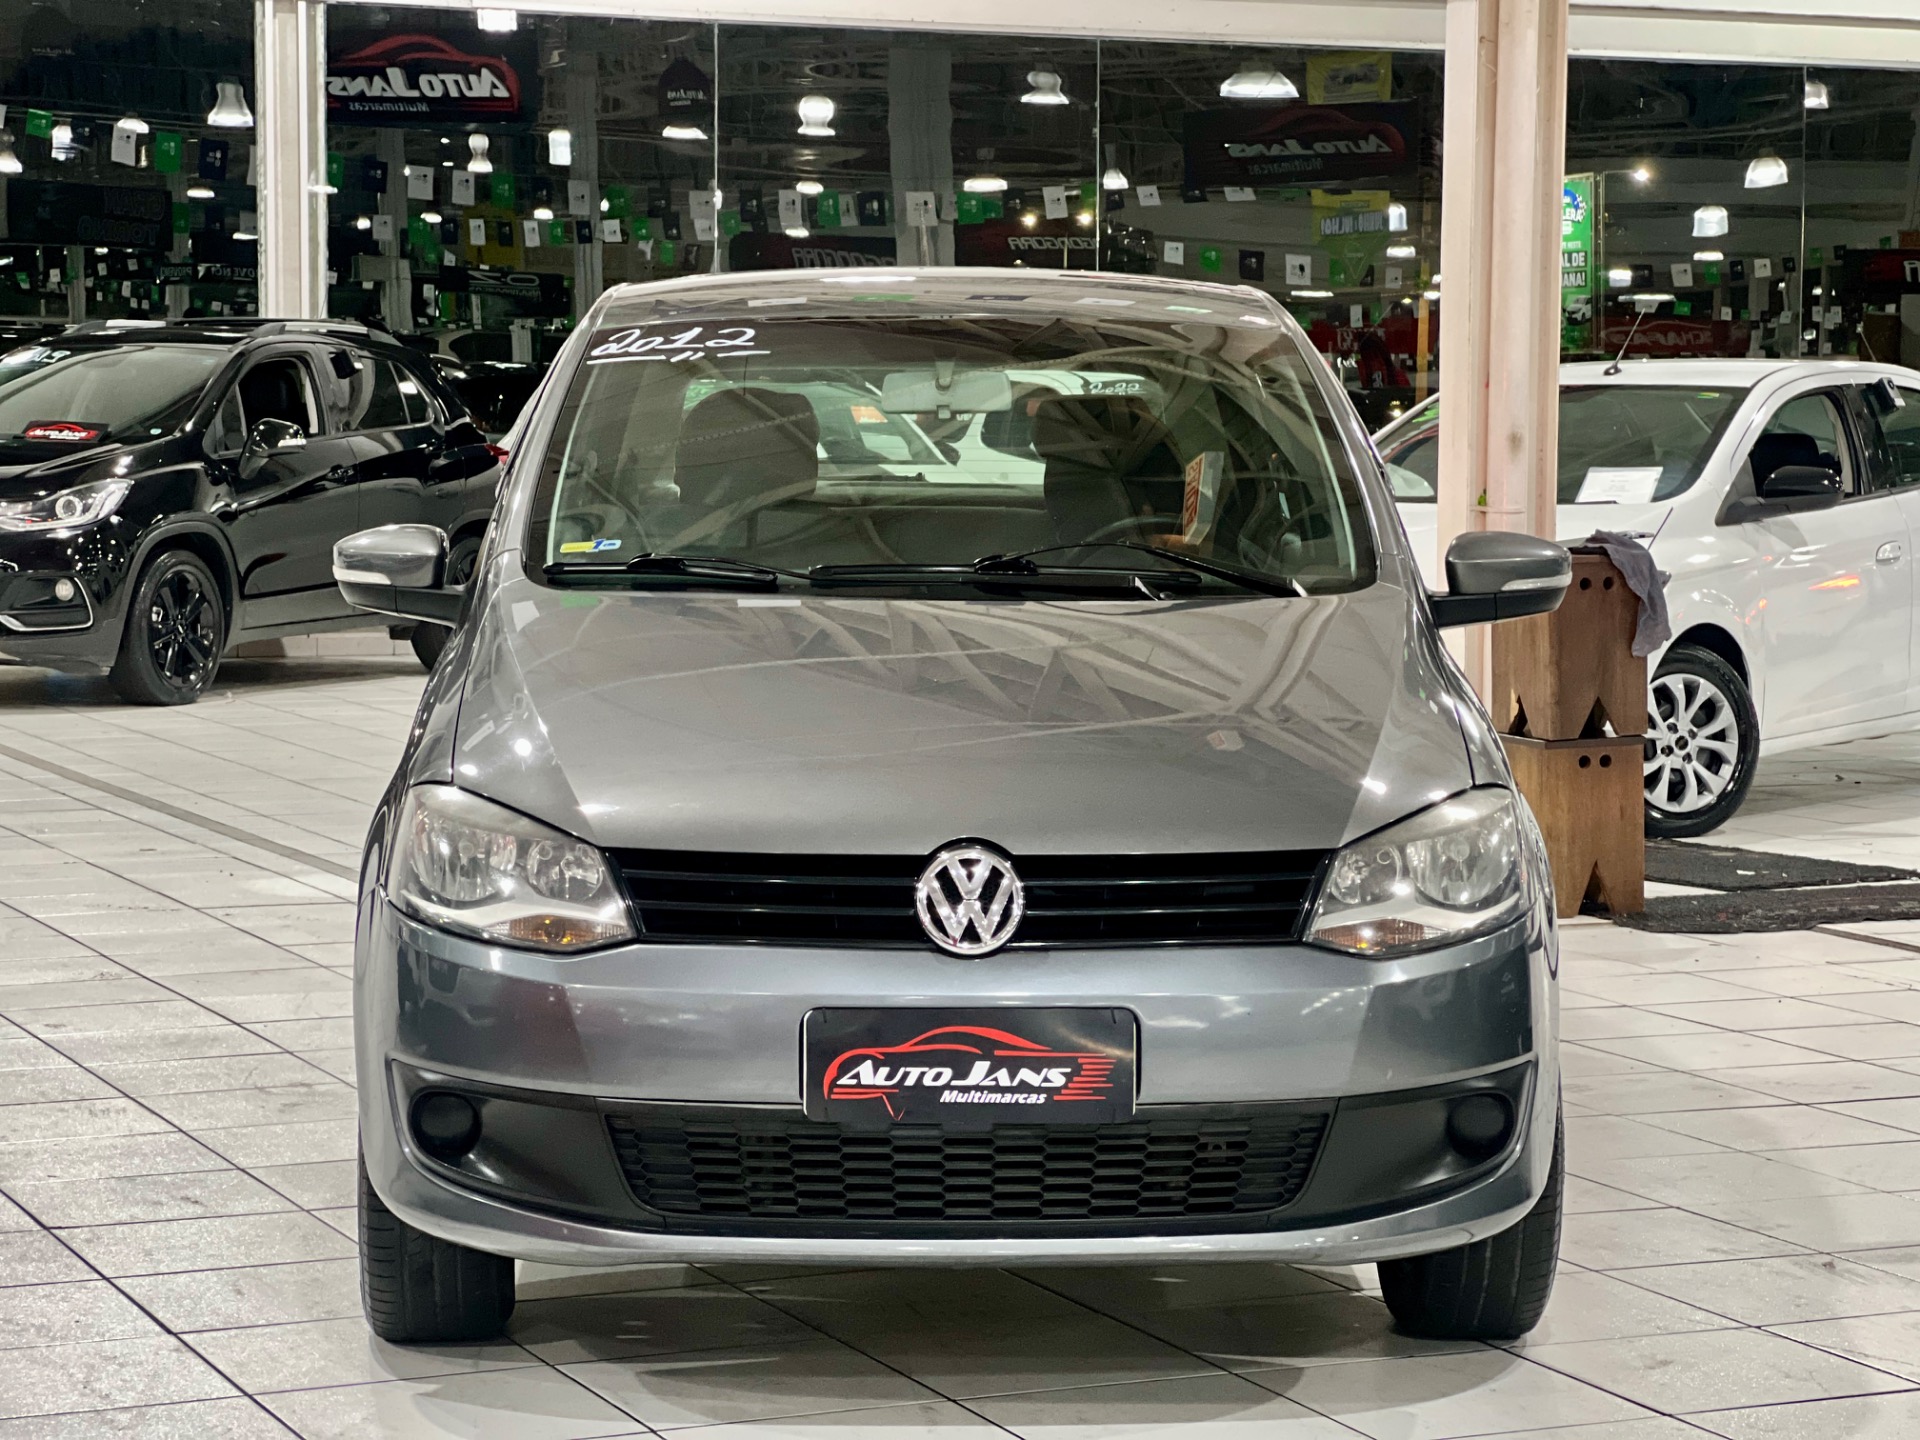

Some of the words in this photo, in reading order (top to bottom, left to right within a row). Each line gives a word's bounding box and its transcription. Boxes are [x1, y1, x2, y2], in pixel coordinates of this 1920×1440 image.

[590, 326, 756, 358] 2012
[836, 1059, 945, 1087] AUTO
[950, 1060, 1072, 1088] JANS
[939, 1089, 1048, 1104] Multimarcas
